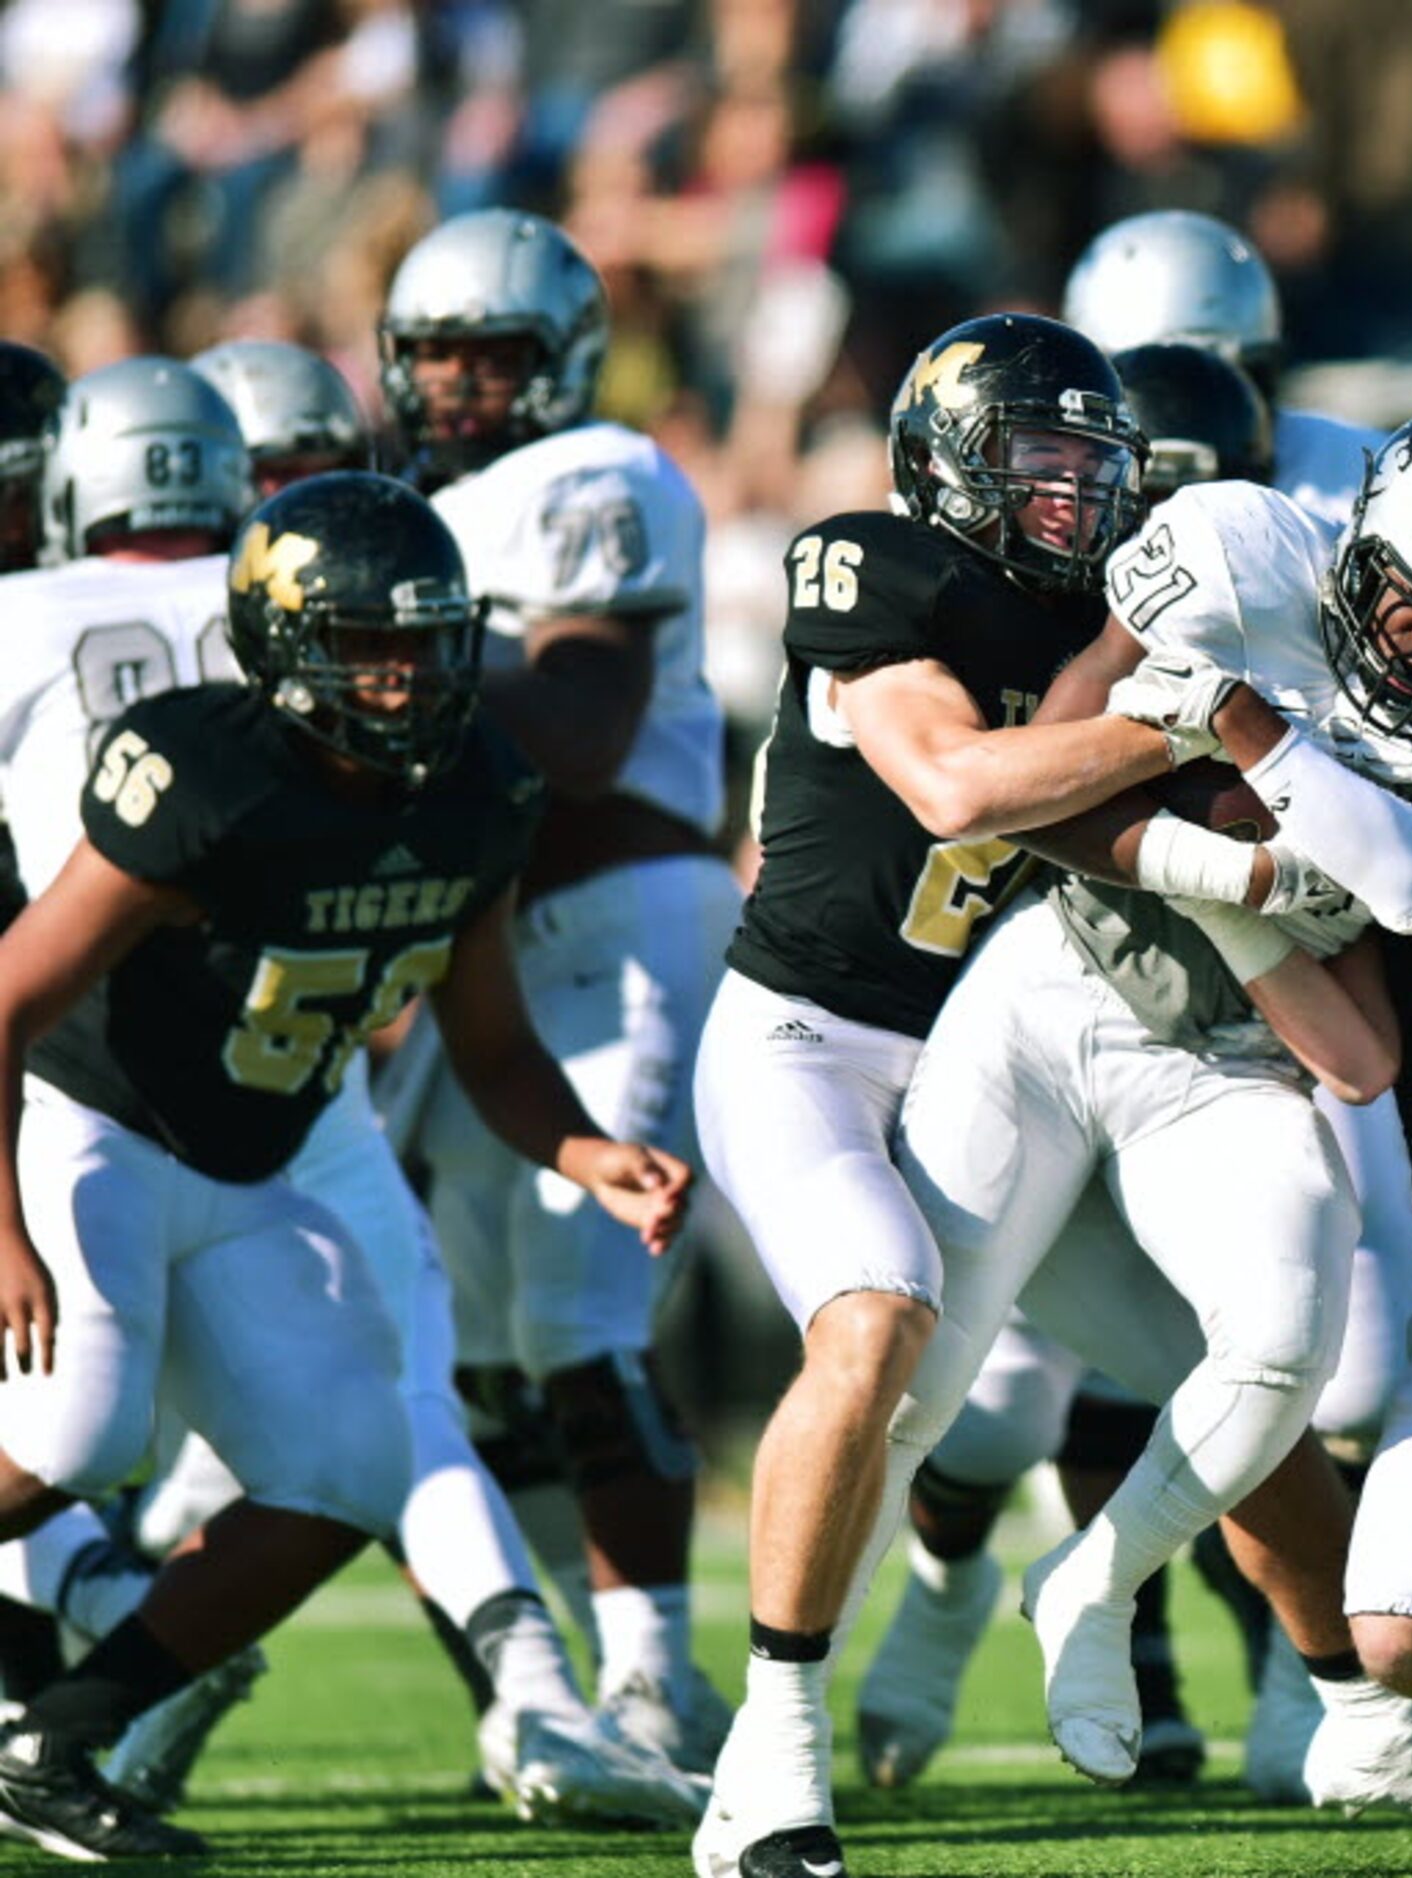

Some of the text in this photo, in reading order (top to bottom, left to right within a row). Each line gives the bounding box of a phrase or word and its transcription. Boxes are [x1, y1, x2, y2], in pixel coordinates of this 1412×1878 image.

[898, 341, 986, 412] M
[145, 440, 203, 487] 83
[231, 522, 320, 613] M
[791, 535, 864, 623] 26
[1109, 523, 1199, 633] 21
[94, 728, 174, 828] 56
[306, 876, 477, 934] TIGERS
